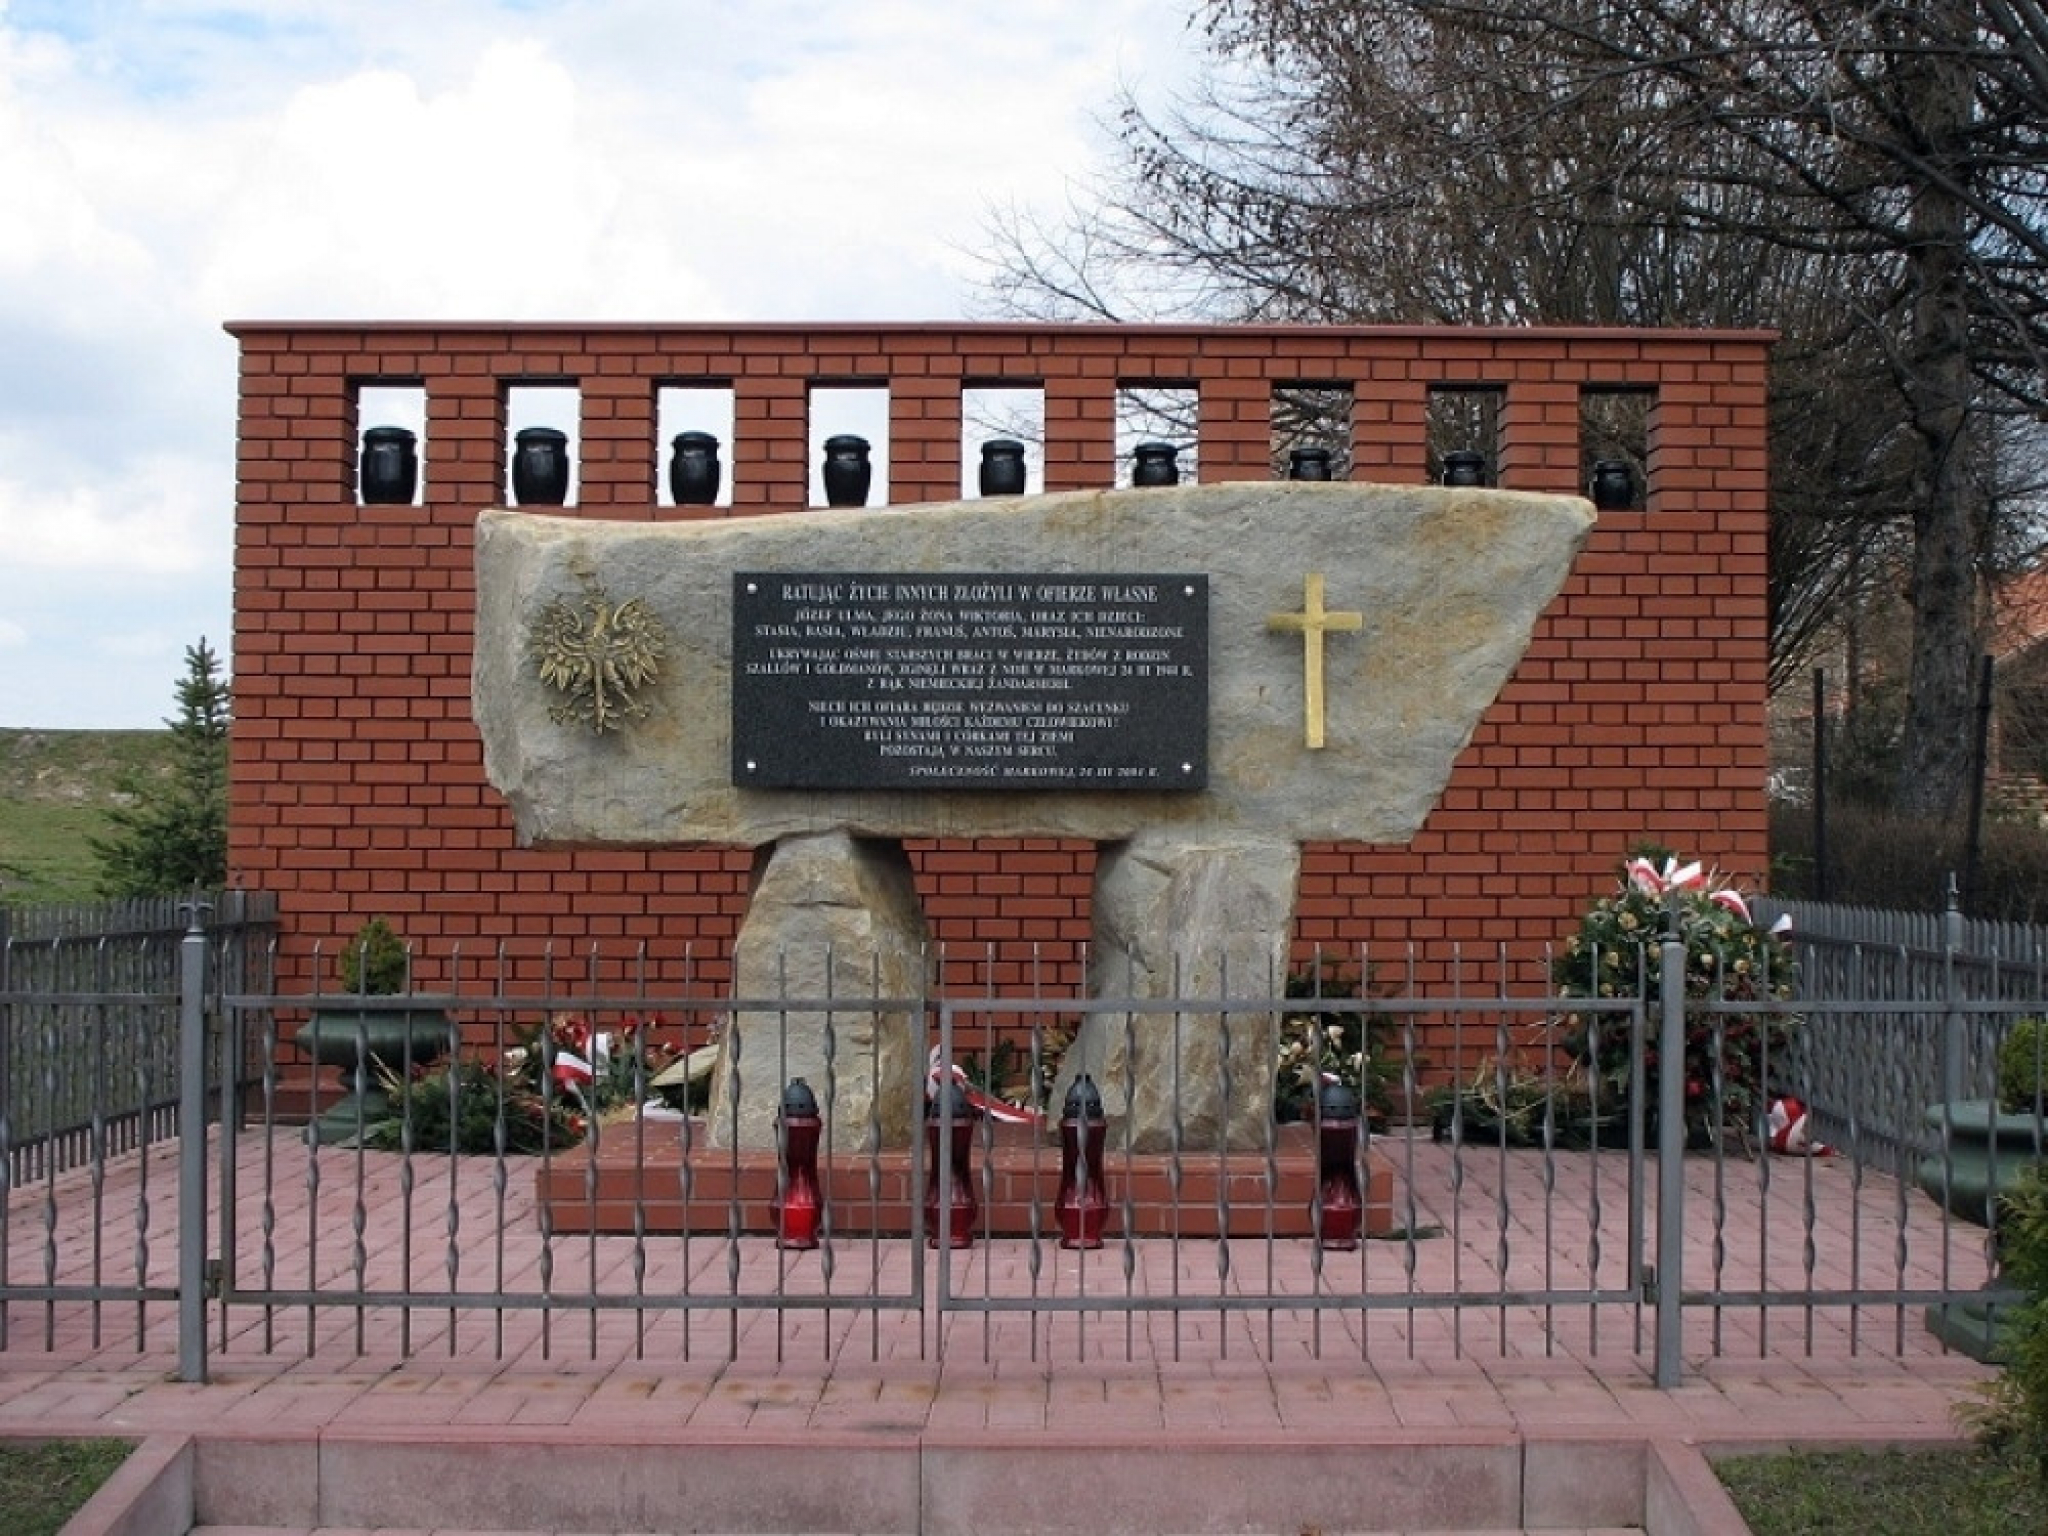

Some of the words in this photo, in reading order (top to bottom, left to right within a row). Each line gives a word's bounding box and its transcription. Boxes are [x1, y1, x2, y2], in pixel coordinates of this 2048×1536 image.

[782, 586, 842, 603] RATUJĄC
[848, 581, 889, 600] ŻYCIE
[895, 586, 949, 600] INNYCH
[954, 582, 1013, 600] ZŁOŻYLI
[1018, 586, 1032, 600] W
